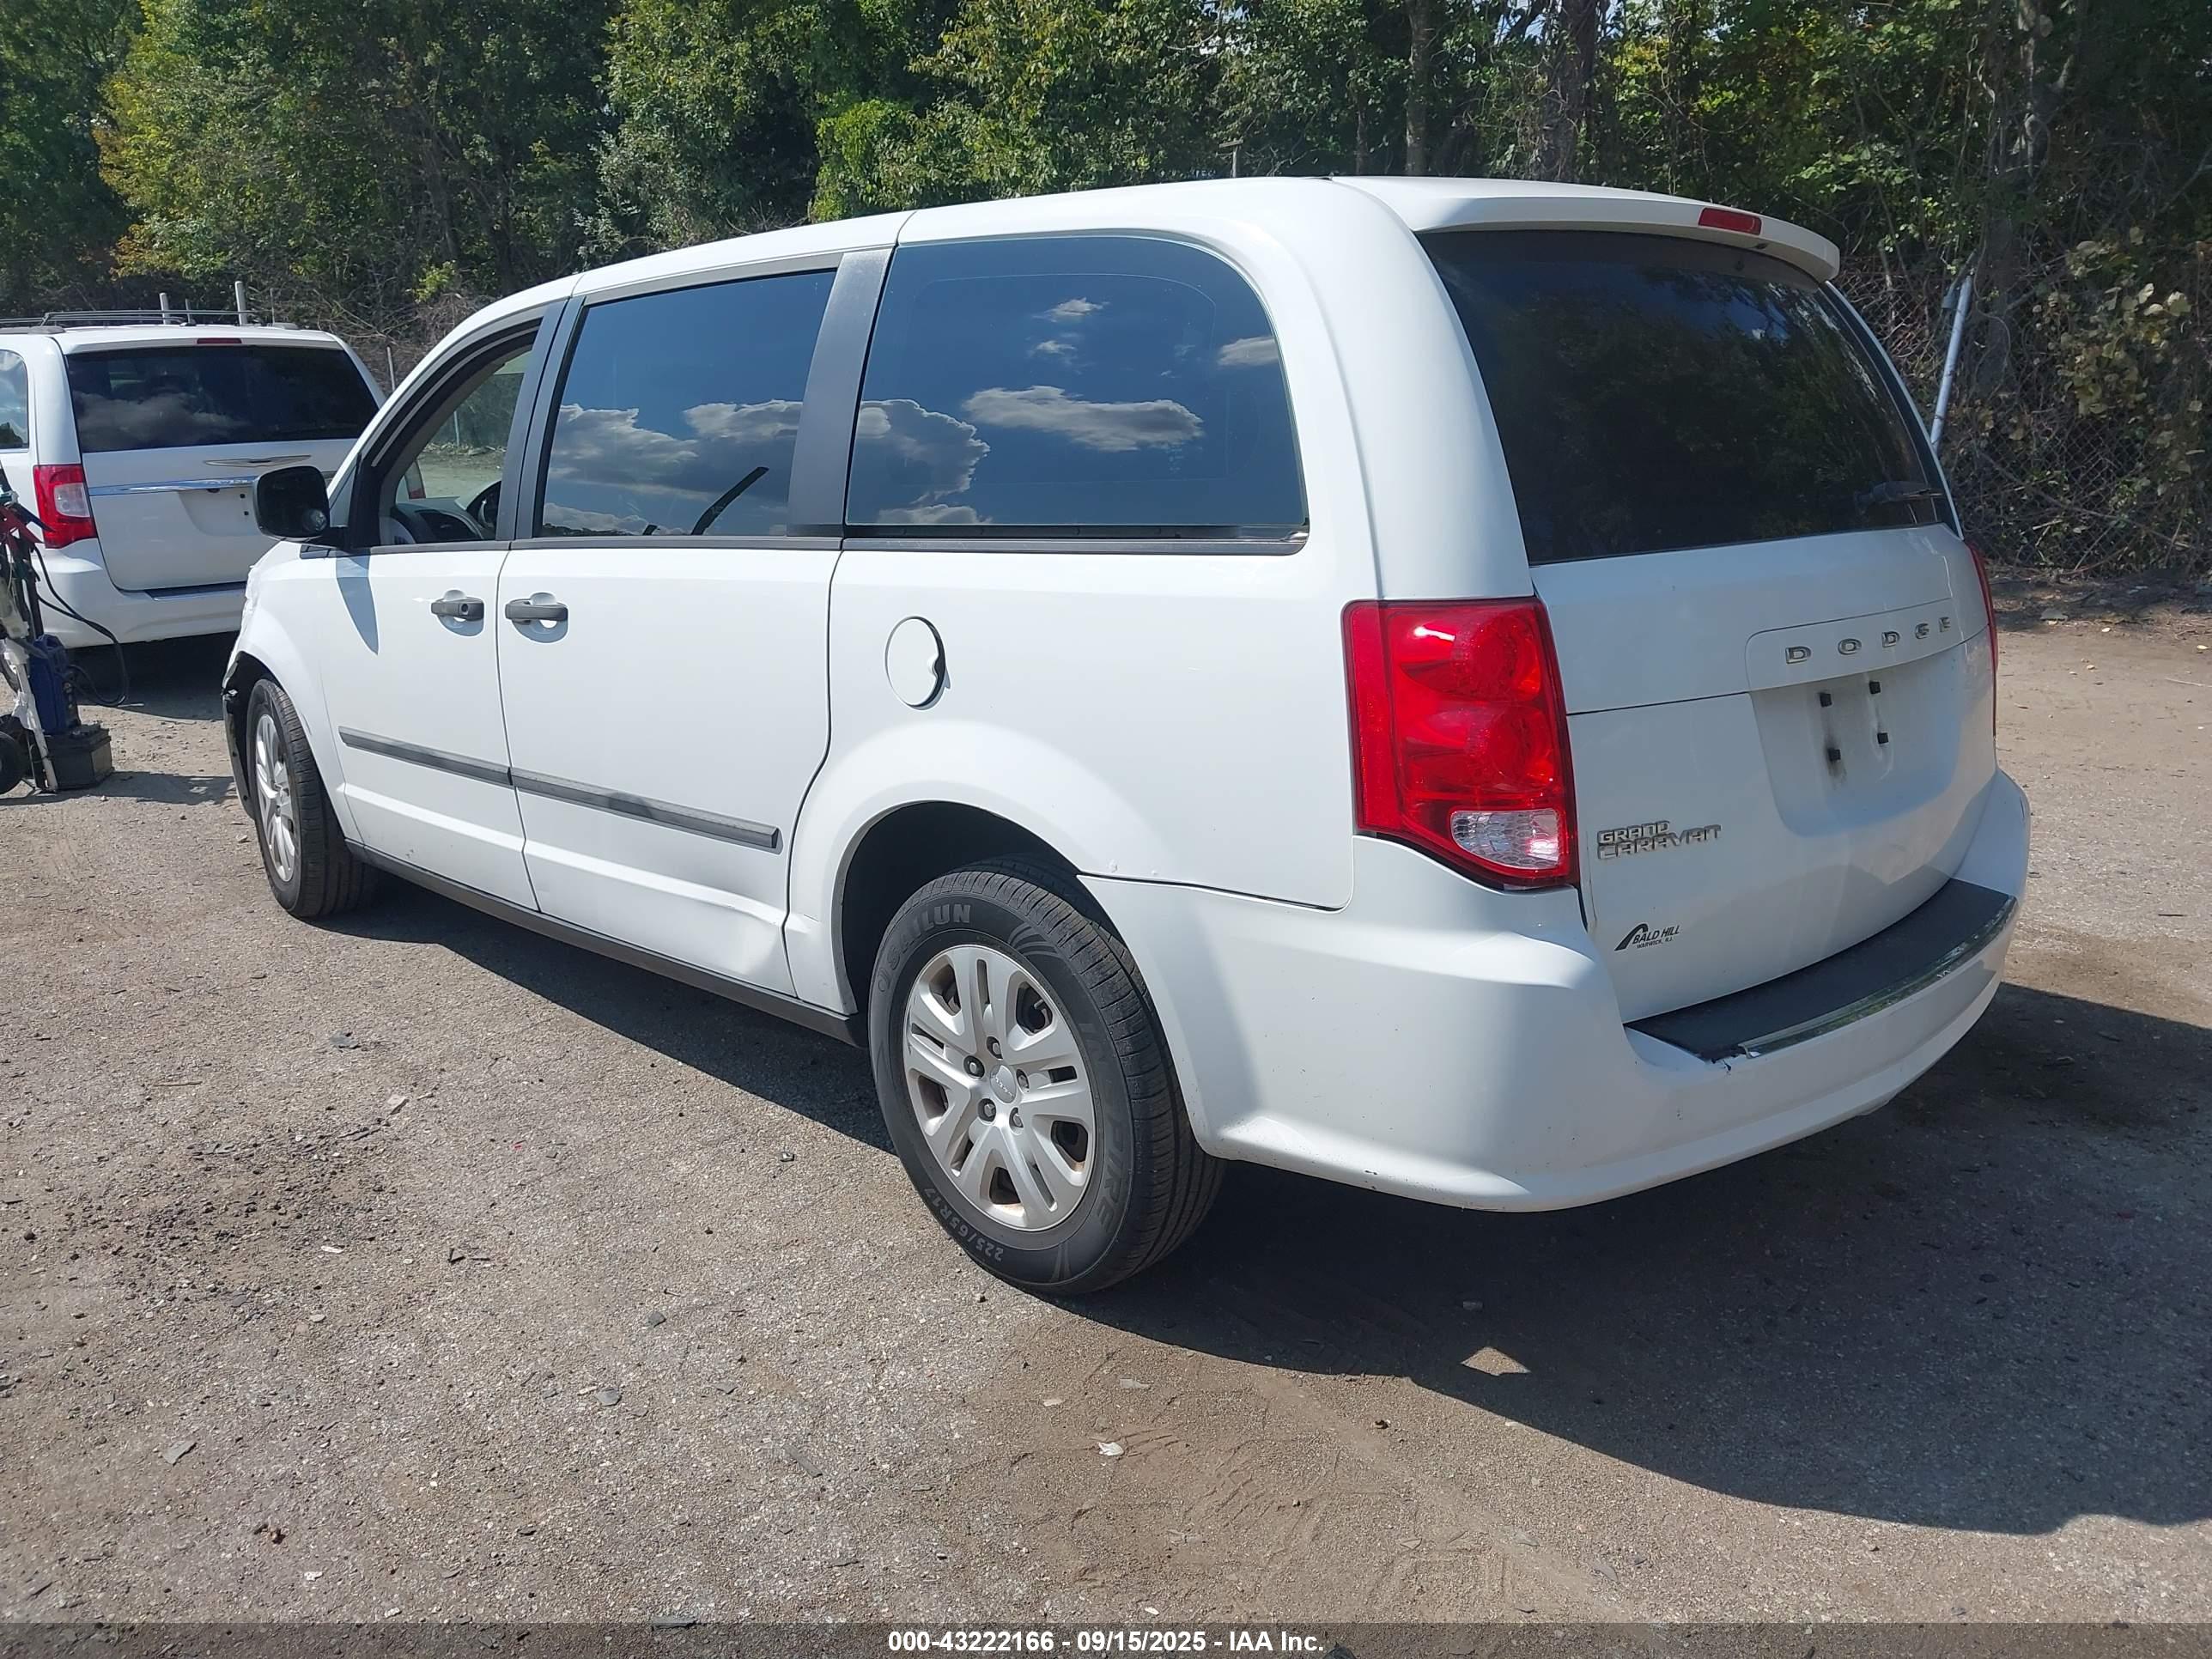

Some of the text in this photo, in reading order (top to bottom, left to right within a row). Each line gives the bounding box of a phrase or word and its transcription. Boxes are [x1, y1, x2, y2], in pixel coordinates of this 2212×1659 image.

[1784, 616, 1952, 665] DODGE
[1597, 820, 1670, 847] GRAND
[1597, 824, 1723, 860] CARAVAN
[886, 903, 971, 970] SAILUN
[1632, 925, 1680, 945] BALD HILL
